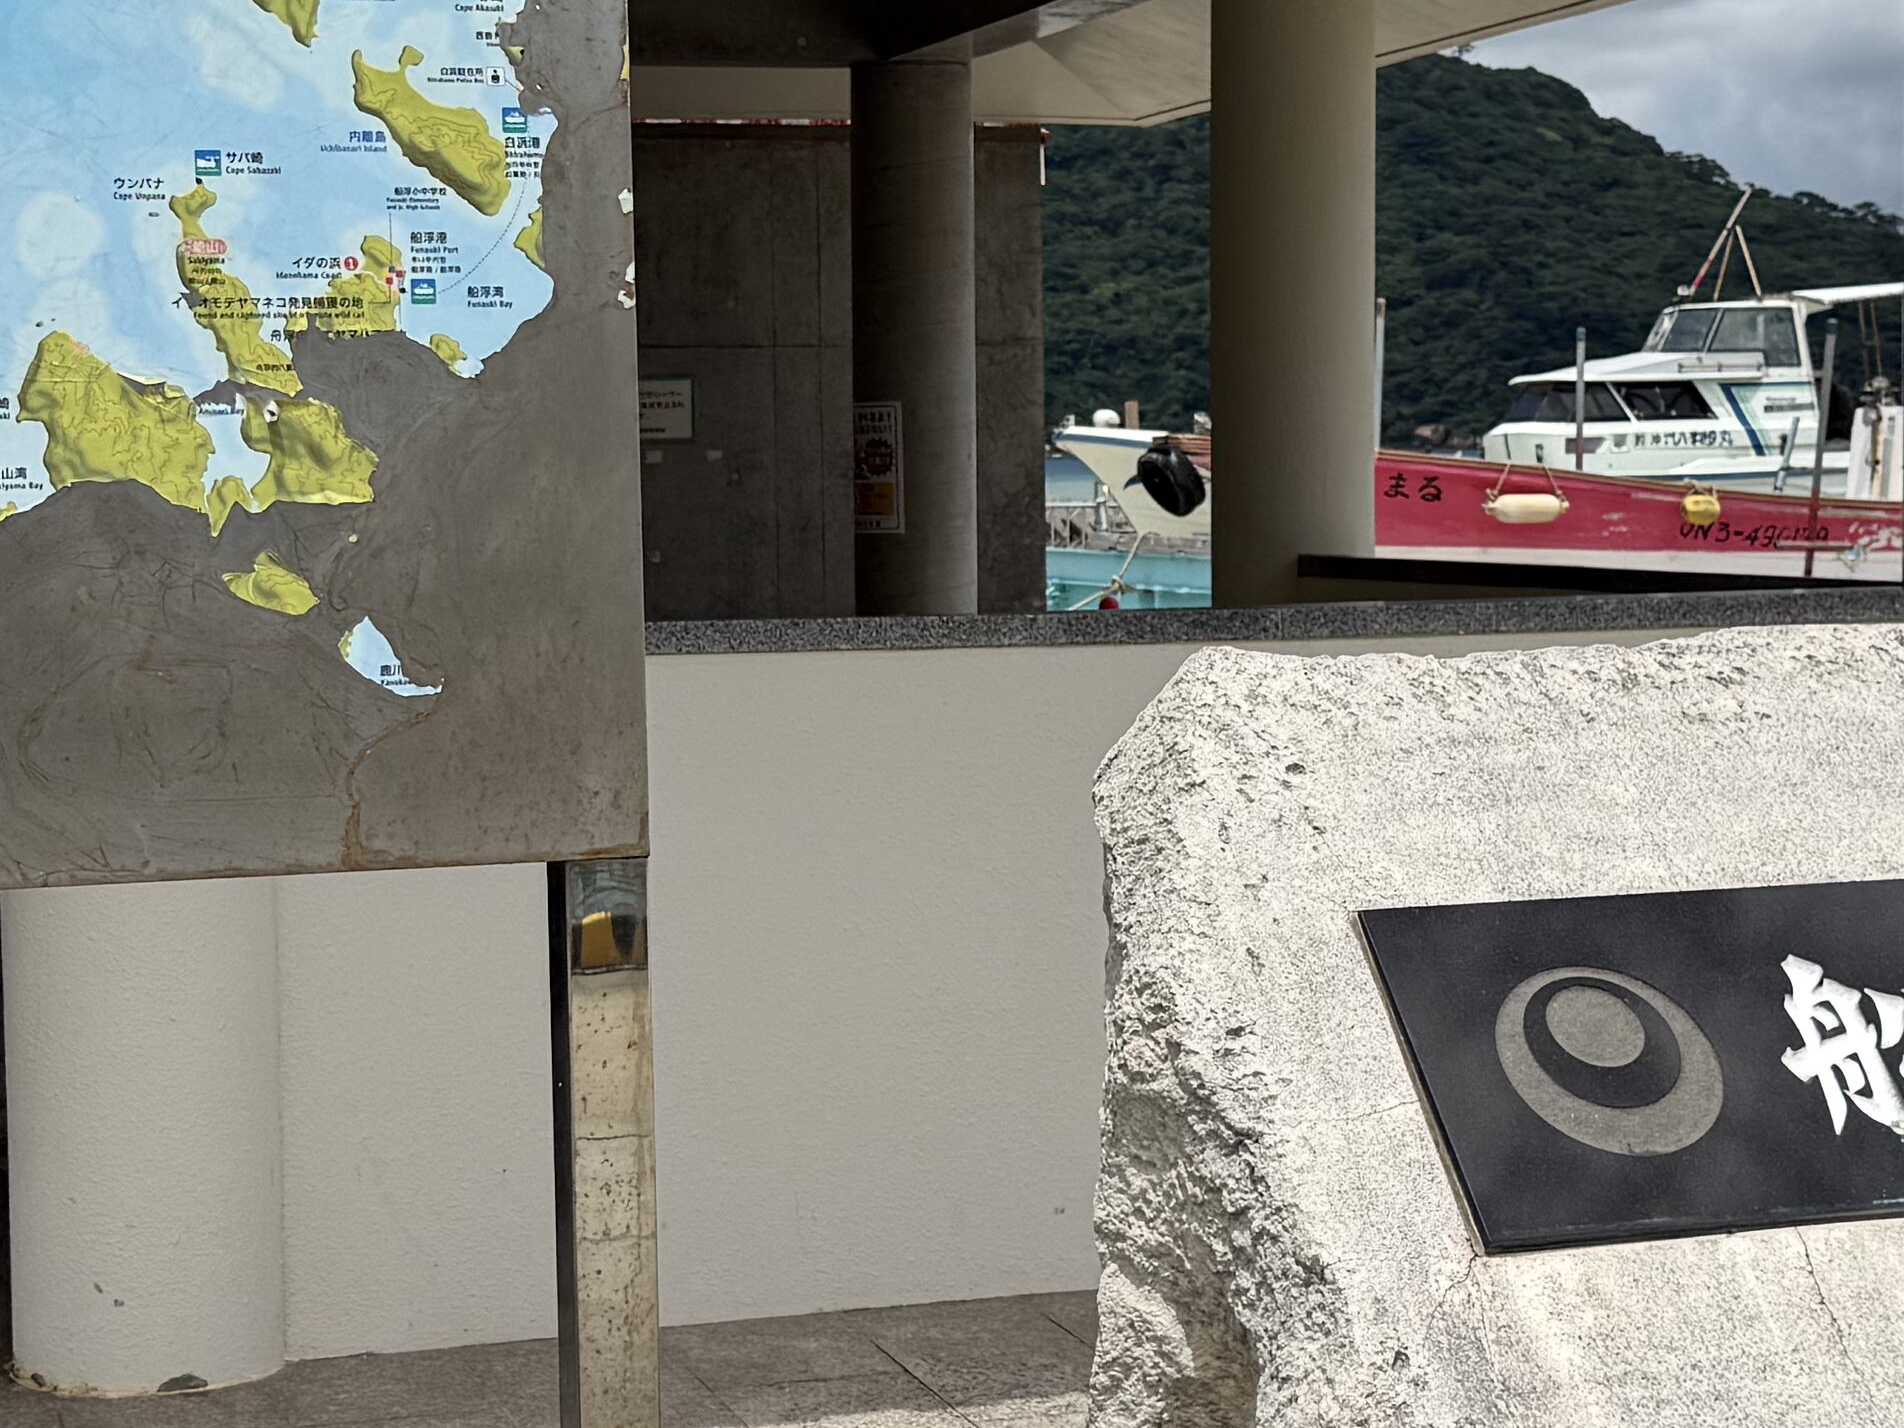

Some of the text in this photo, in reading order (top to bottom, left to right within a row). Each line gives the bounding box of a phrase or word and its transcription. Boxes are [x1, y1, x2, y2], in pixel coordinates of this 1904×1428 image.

[455, 4, 473, 12] Cape
[226, 166, 244, 175] Cape
[114, 192, 132, 201] Cape
[410, 231, 447, 244] 船浮港
[292, 256, 342, 269] イダの浜
[172, 296, 364, 310] イオモテヤマネコ発見捕獲の地
[1384, 472, 1442, 502] まる
